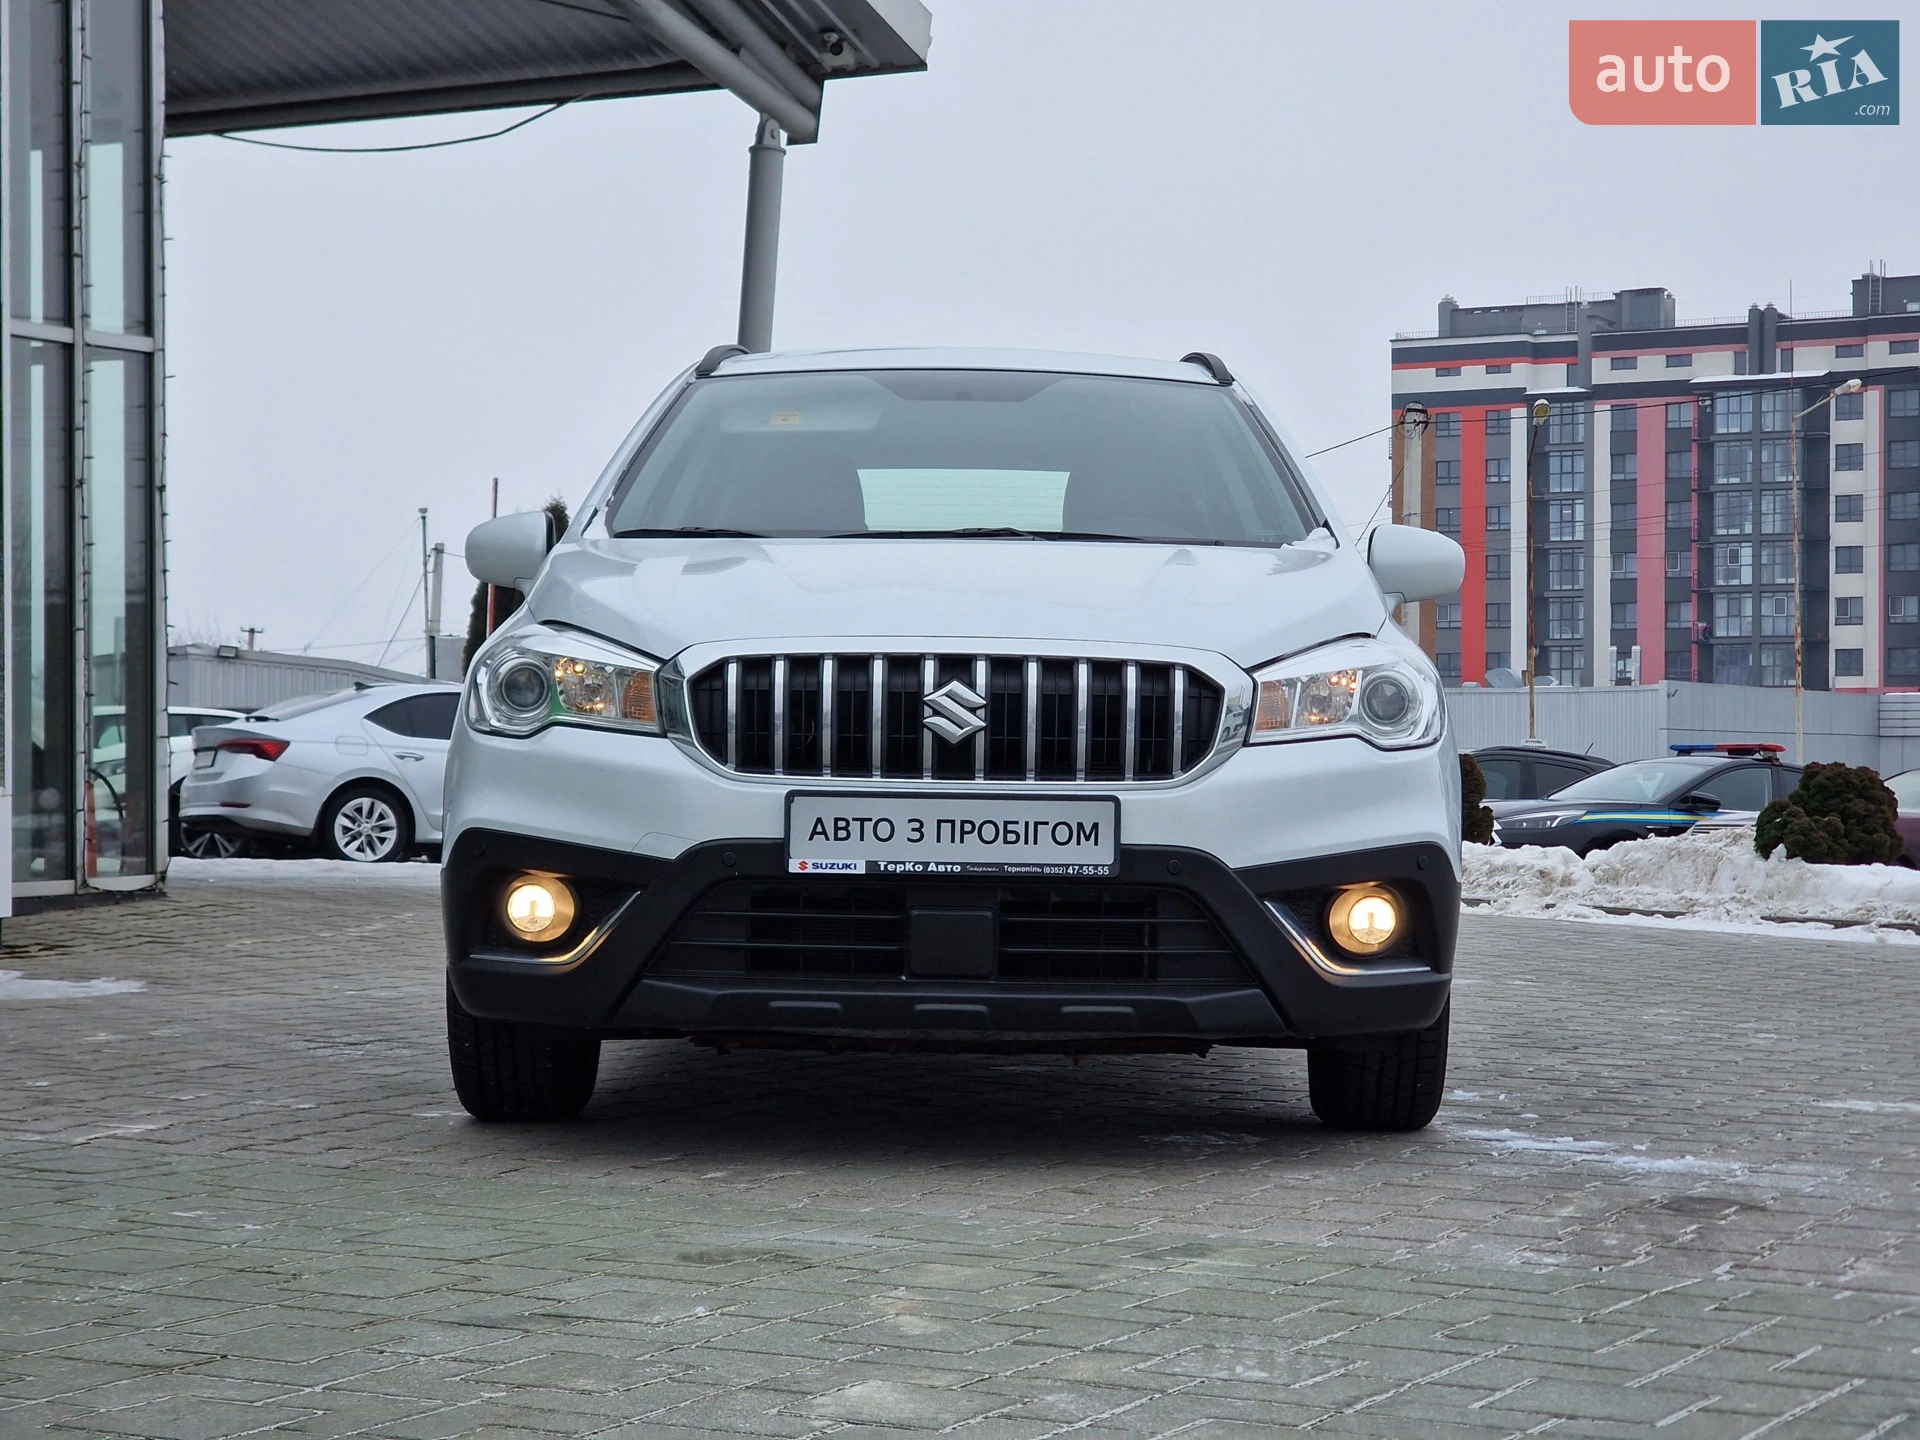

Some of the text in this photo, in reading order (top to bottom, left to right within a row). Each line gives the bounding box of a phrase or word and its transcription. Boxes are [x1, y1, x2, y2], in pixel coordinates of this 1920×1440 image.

[808, 816, 896, 843] АВТО
[936, 818, 1100, 847] ПРОБІГОМ
[811, 862, 857, 871] SUZUKI
[1043, 865, 1066, 875] (0352)
[1067, 865, 1110, 876] 47-55-55
